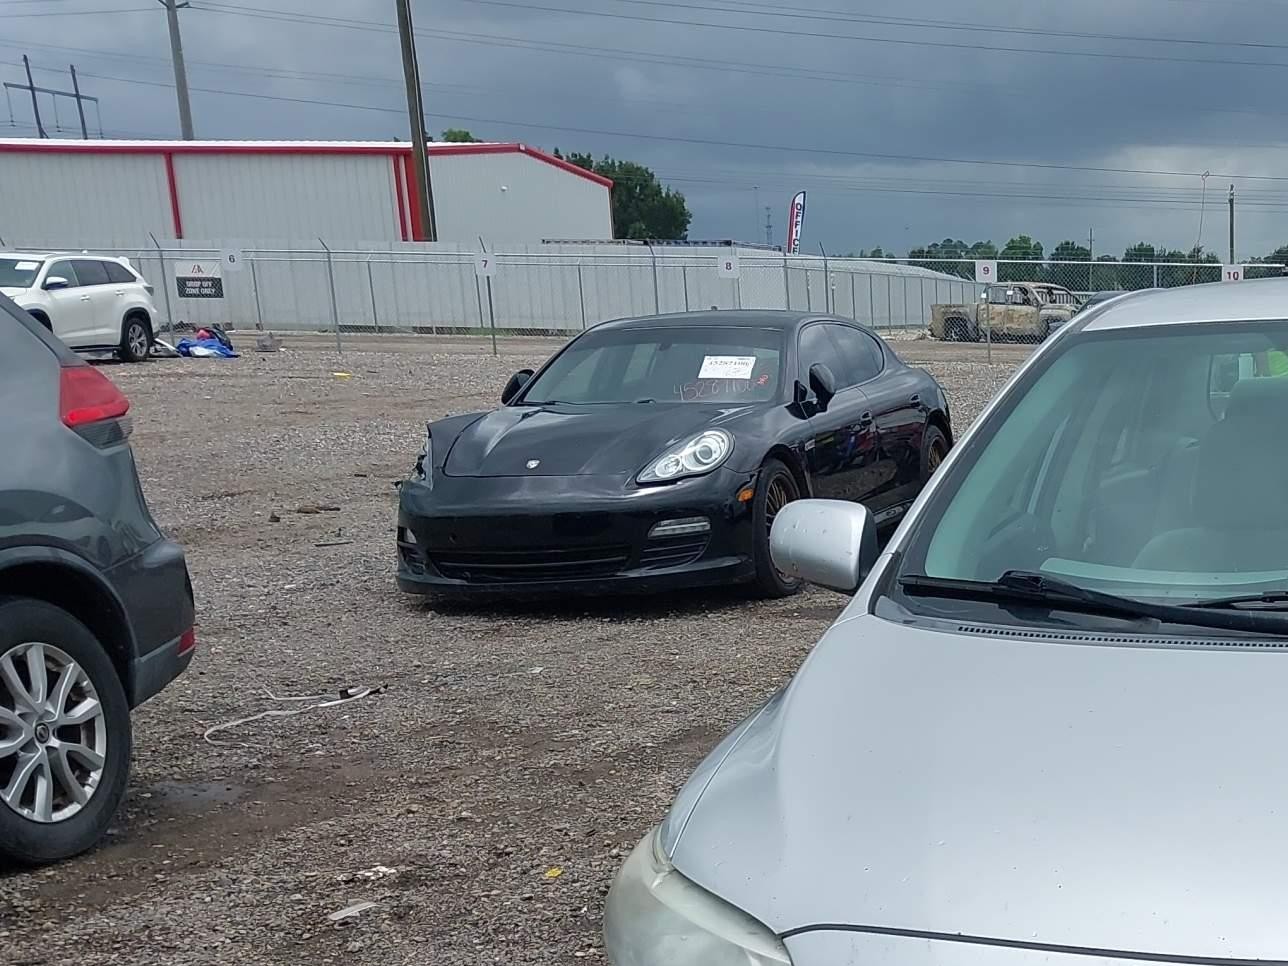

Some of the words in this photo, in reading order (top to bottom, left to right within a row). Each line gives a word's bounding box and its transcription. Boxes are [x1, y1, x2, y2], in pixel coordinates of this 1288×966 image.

[228, 254, 236, 263] 6
[481, 259, 488, 269] 7
[725, 262, 732, 271] 8
[982, 266, 990, 275] 9
[1227, 271, 1240, 281] 10
